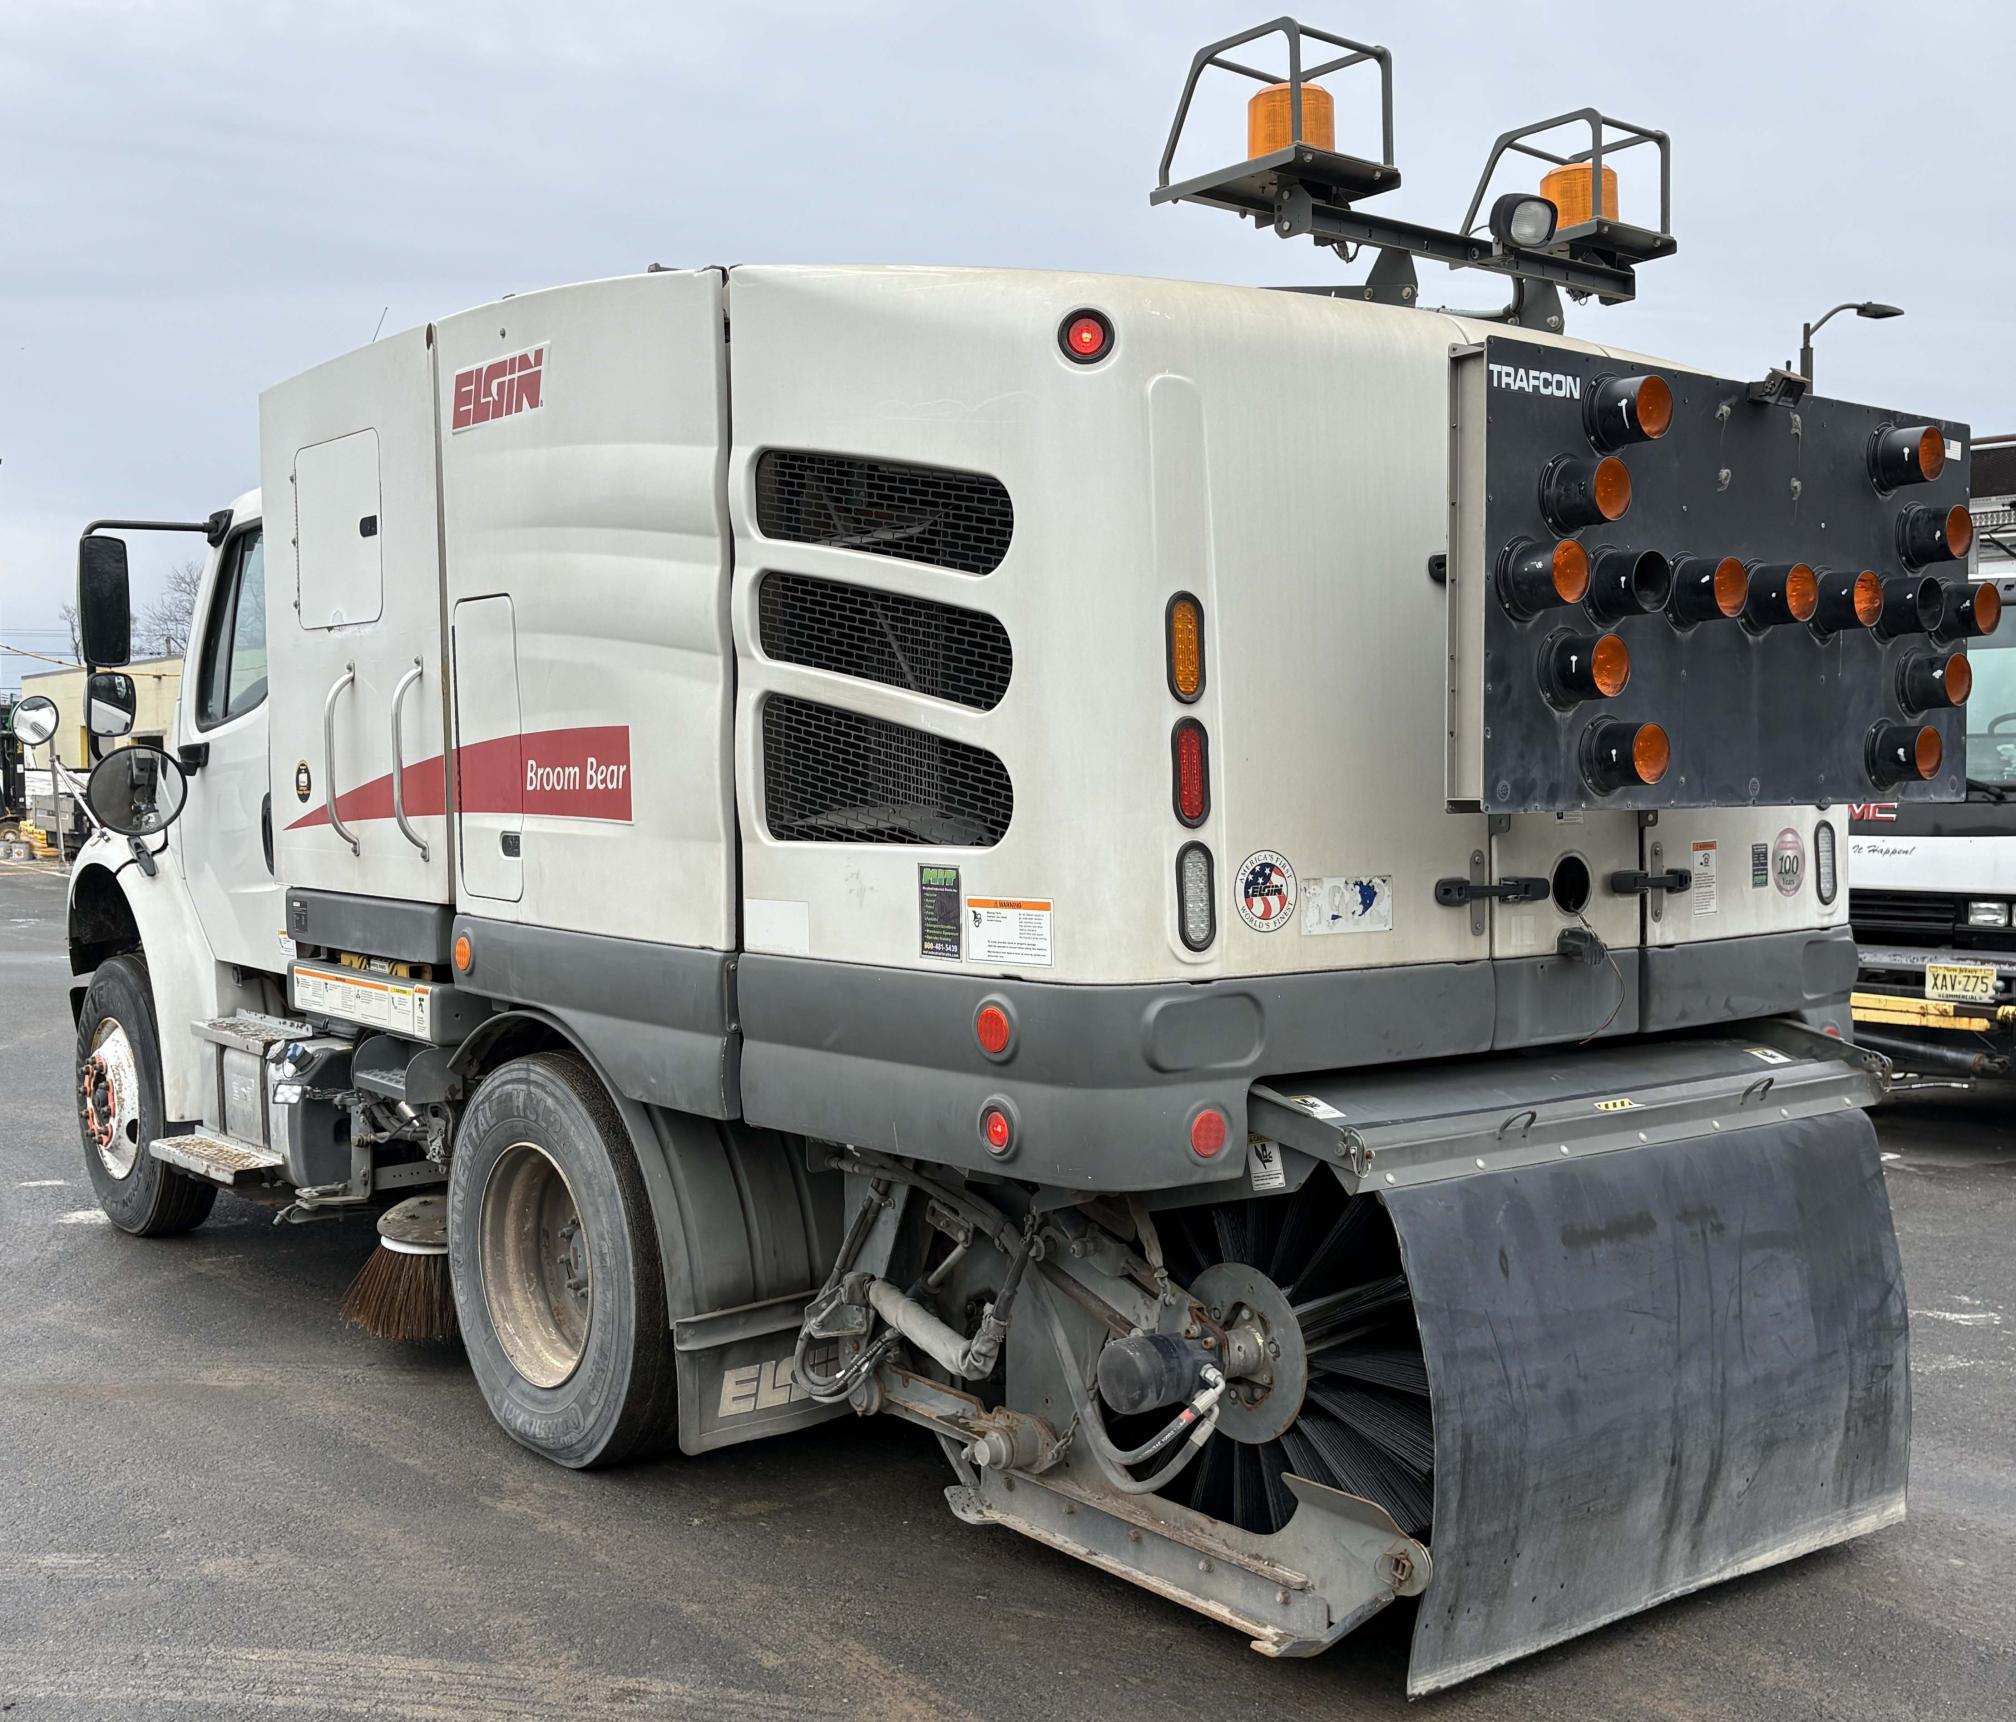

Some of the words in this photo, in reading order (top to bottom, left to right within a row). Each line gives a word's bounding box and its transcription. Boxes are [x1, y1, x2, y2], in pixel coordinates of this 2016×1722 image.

[452, 347, 544, 430] ELGIN
[1488, 363, 1581, 399] TRAFCON
[526, 759, 580, 791] Broom
[586, 757, 627, 789] Bear
[1847, 802, 1898, 822] MC
[1867, 844, 1916, 856] Happen!
[1239, 854, 1274, 884] AMERICA'S
[1275, 857, 1293, 879] FIRST
[1777, 855, 1799, 875] 100
[1251, 884, 1284, 898] ELGIN
[1240, 904, 1271, 930] WORLD'S
[1273, 901, 1293, 928] FINEST
